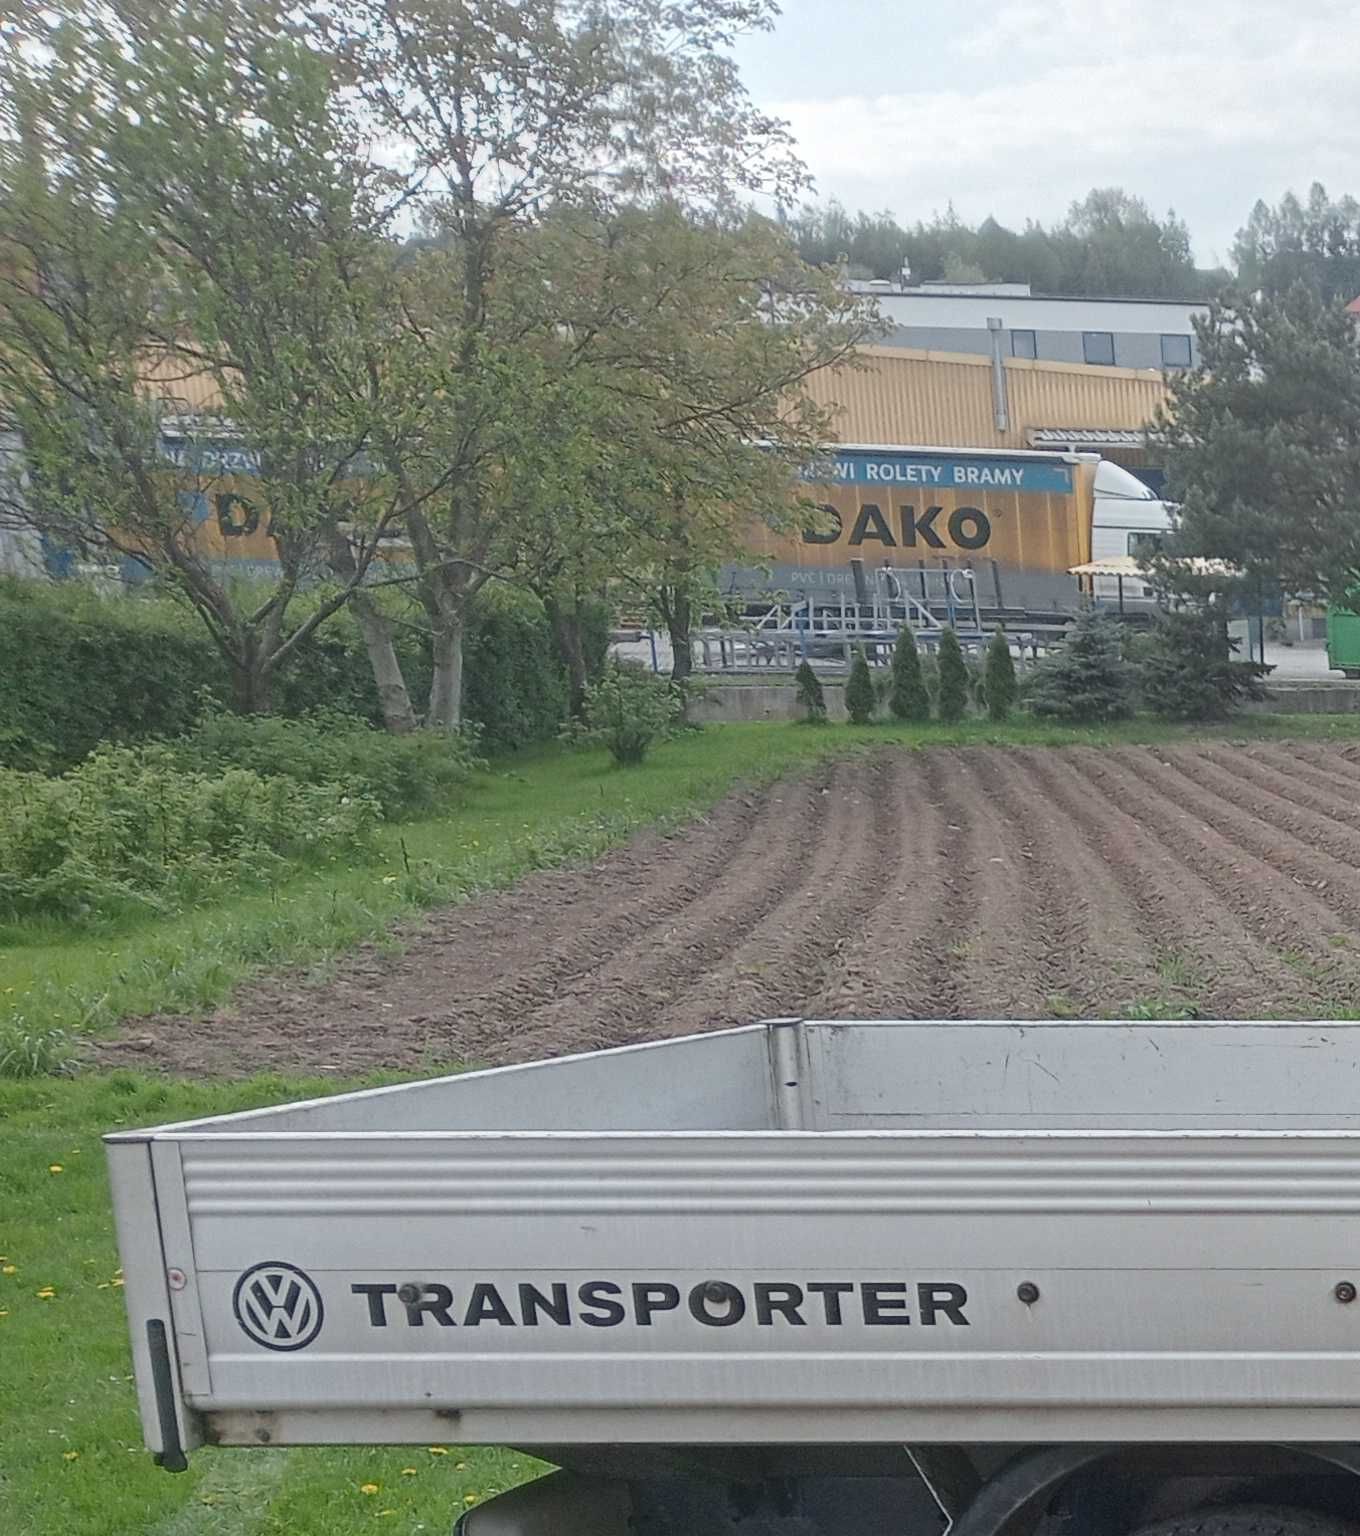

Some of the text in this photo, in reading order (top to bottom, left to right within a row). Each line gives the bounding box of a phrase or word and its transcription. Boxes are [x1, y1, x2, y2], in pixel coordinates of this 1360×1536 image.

[866, 463, 943, 482] ROLETY
[953, 467, 1025, 485] BRAMY
[791, 573, 816, 585] PVC
[351, 1280, 971, 1327] TRANSPORTER
